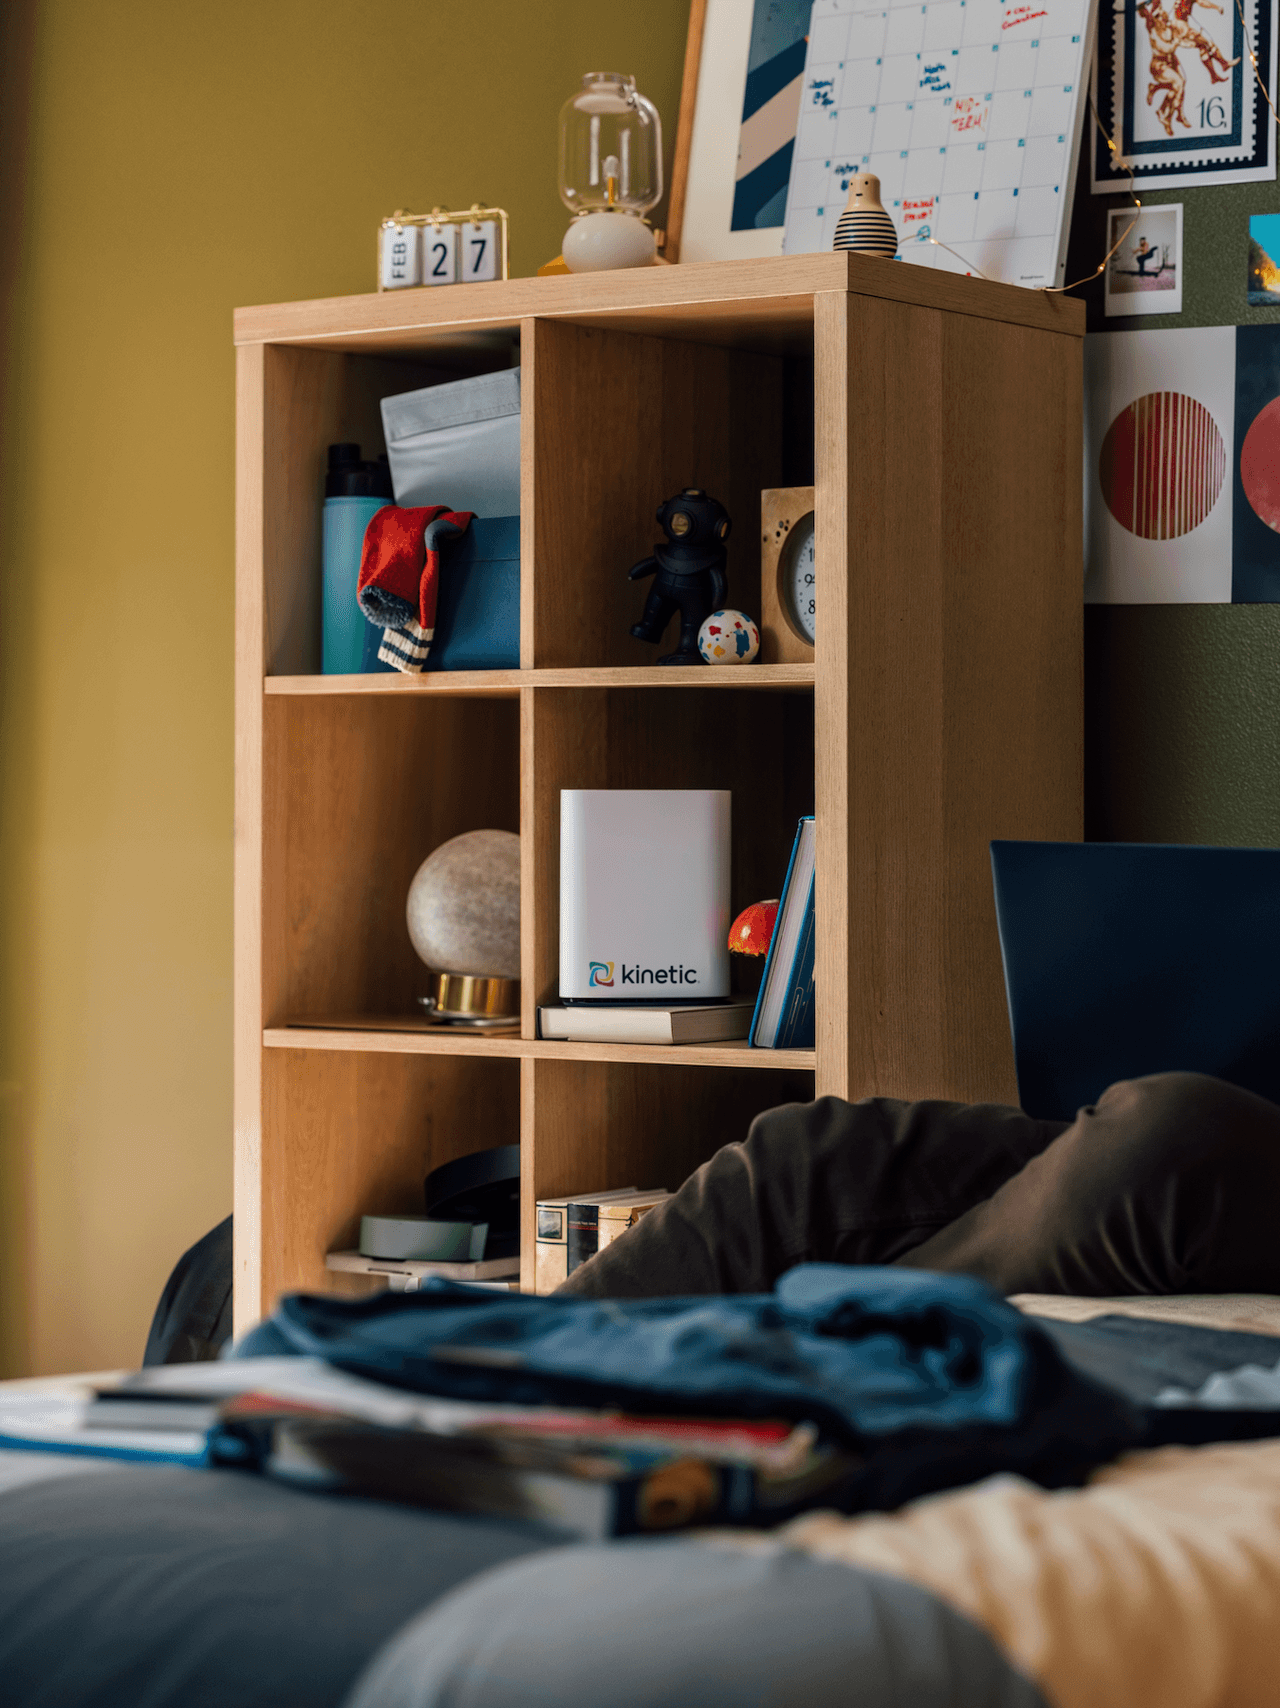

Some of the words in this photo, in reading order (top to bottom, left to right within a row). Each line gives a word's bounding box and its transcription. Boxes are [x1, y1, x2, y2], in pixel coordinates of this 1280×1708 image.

[1196, 96, 1227, 129] 16
[392, 243, 408, 279] FEB
[621, 964, 698, 984] kinetic
